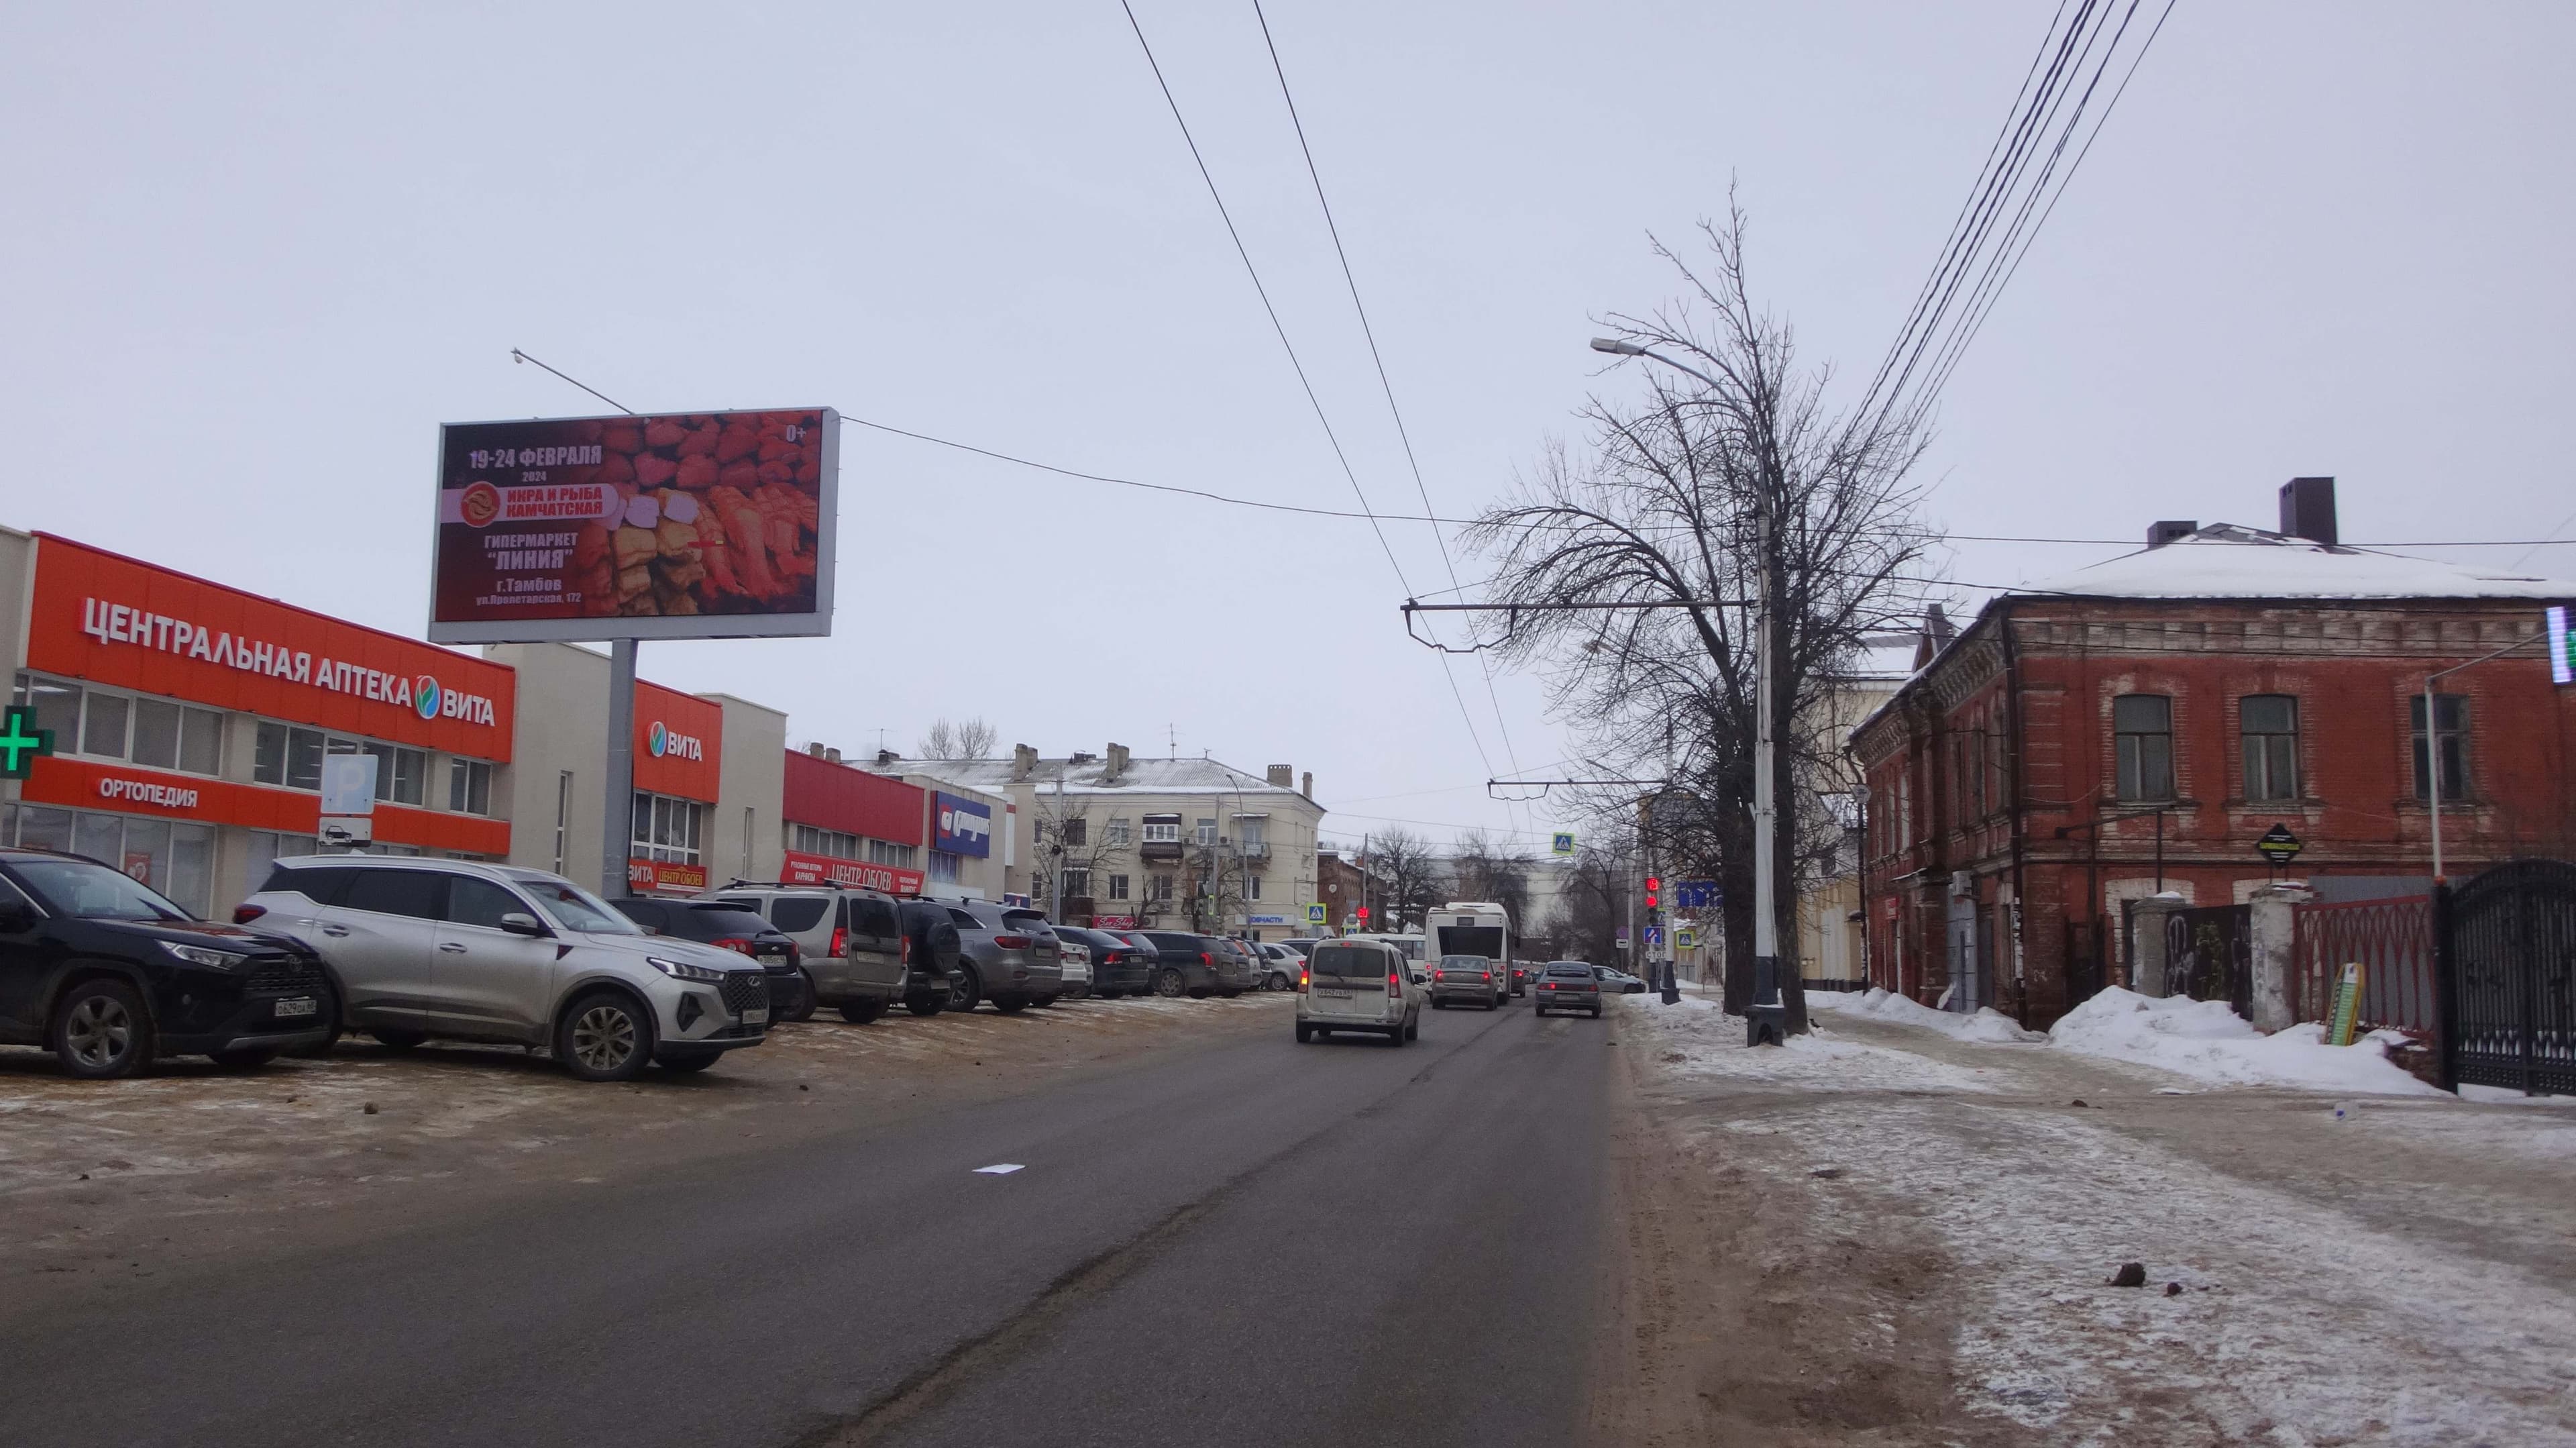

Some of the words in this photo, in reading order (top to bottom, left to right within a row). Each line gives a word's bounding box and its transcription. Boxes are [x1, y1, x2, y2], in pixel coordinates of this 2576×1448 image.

[787, 425, 806, 442] 0+
[470, 449, 515, 468] 19-24
[519, 446, 602, 466] ФЕВРАЛЯ
[522, 471, 547, 482] 2024
[507, 489, 543, 503] ИКРА
[547, 488, 557, 502] И
[560, 486, 602, 502] РЫБА
[506, 501, 603, 518] КАМЧАТСКАЯ
[484, 532, 578, 548] ГИПЕРМАРКЕТ
[567, 592, 582, 603] 172
[84, 597, 311, 684] ЦЕНТРАЛЬНАЯ
[315, 658, 412, 707] АПТЕКА
[443, 688, 496, 727] ВИТА
[667, 731, 702, 762] ВИТА
[101, 778, 198, 808] ОРТОПЕДИЯ
[628, 864, 653, 883] ВИТА
[659, 869, 680, 883] ЦЕНТР
[680, 873, 703, 886] ОБОЕВ
[831, 864, 861, 884] ЦЕНТР
[863, 868, 892, 891] ОБОЕВ
